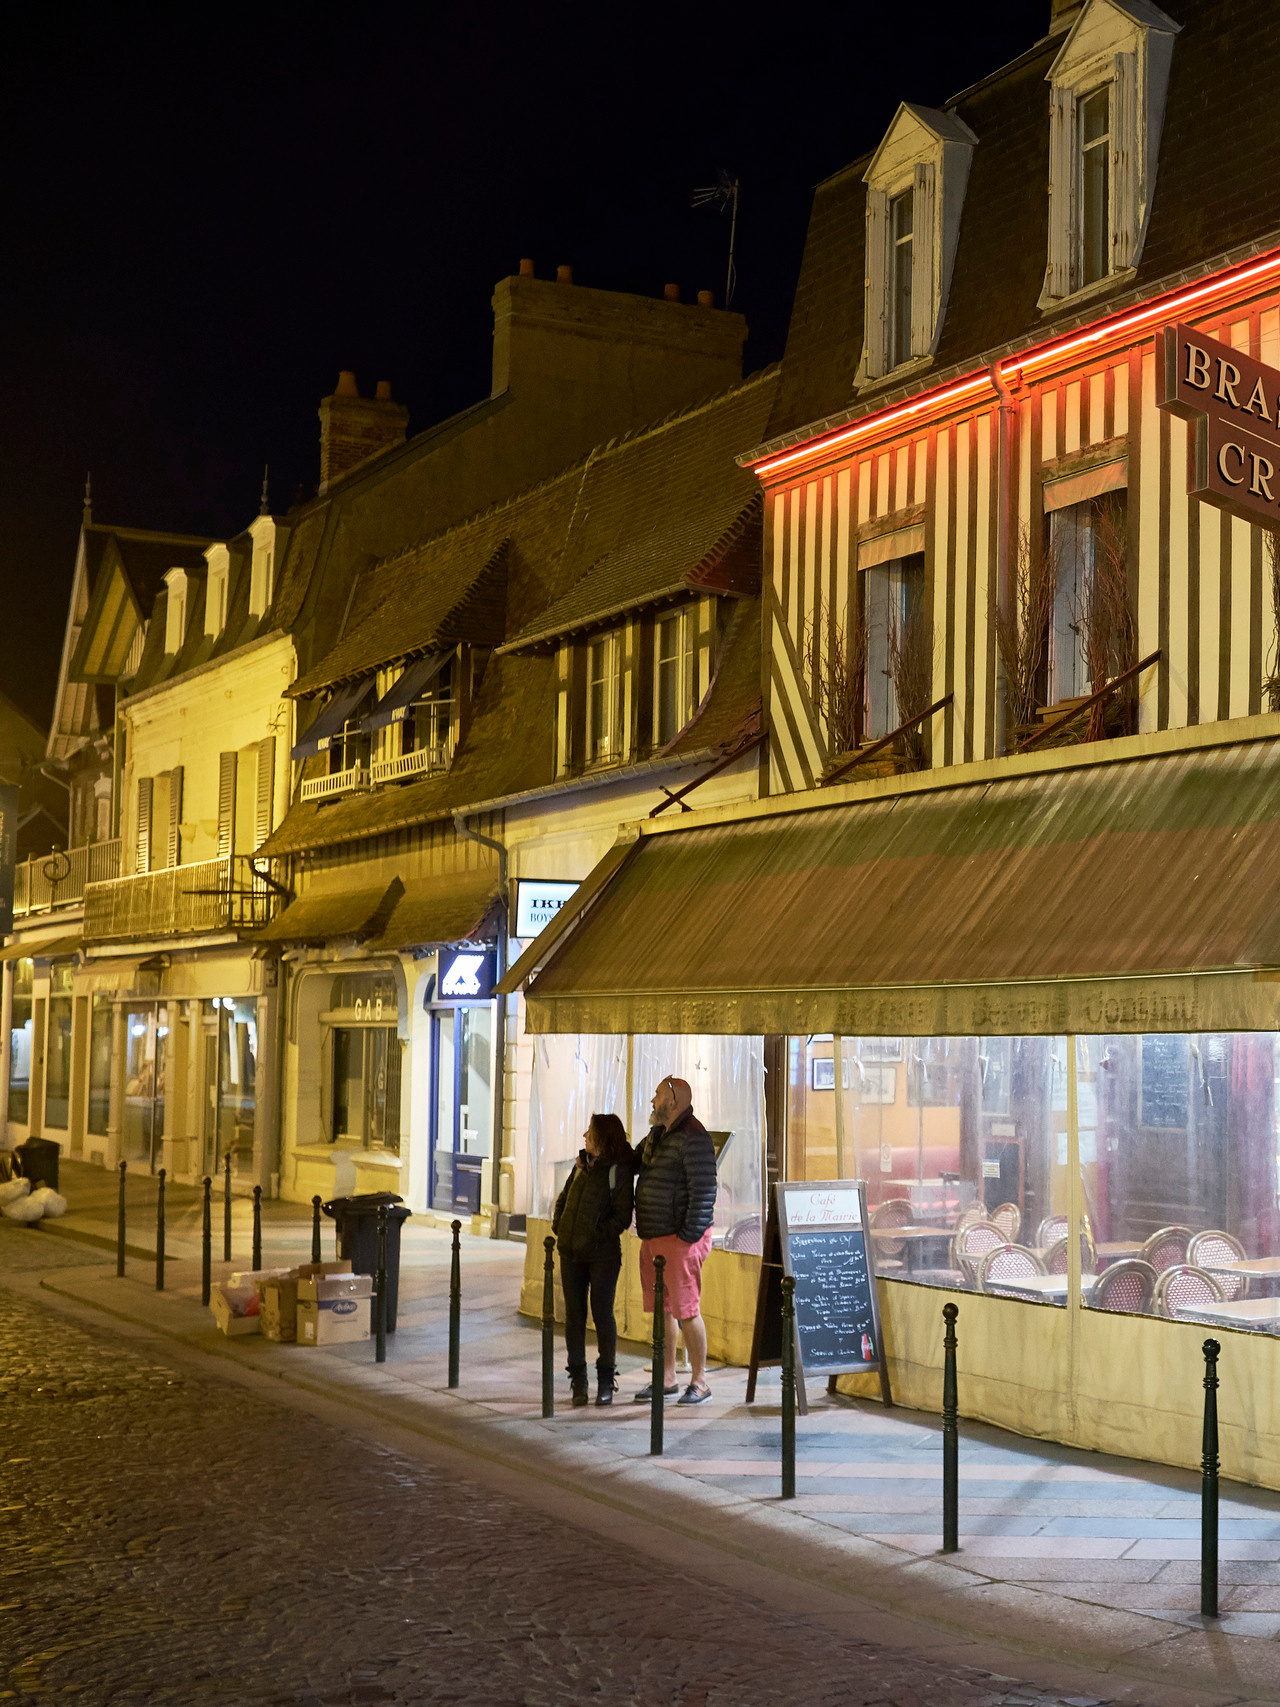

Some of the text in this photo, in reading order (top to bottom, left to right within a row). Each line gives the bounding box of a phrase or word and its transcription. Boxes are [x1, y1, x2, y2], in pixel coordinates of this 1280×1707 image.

[354, 998, 383, 1021] GAB
[810, 1192, 836, 1208] Café
[790, 1208, 858, 1223] de la Mairie
